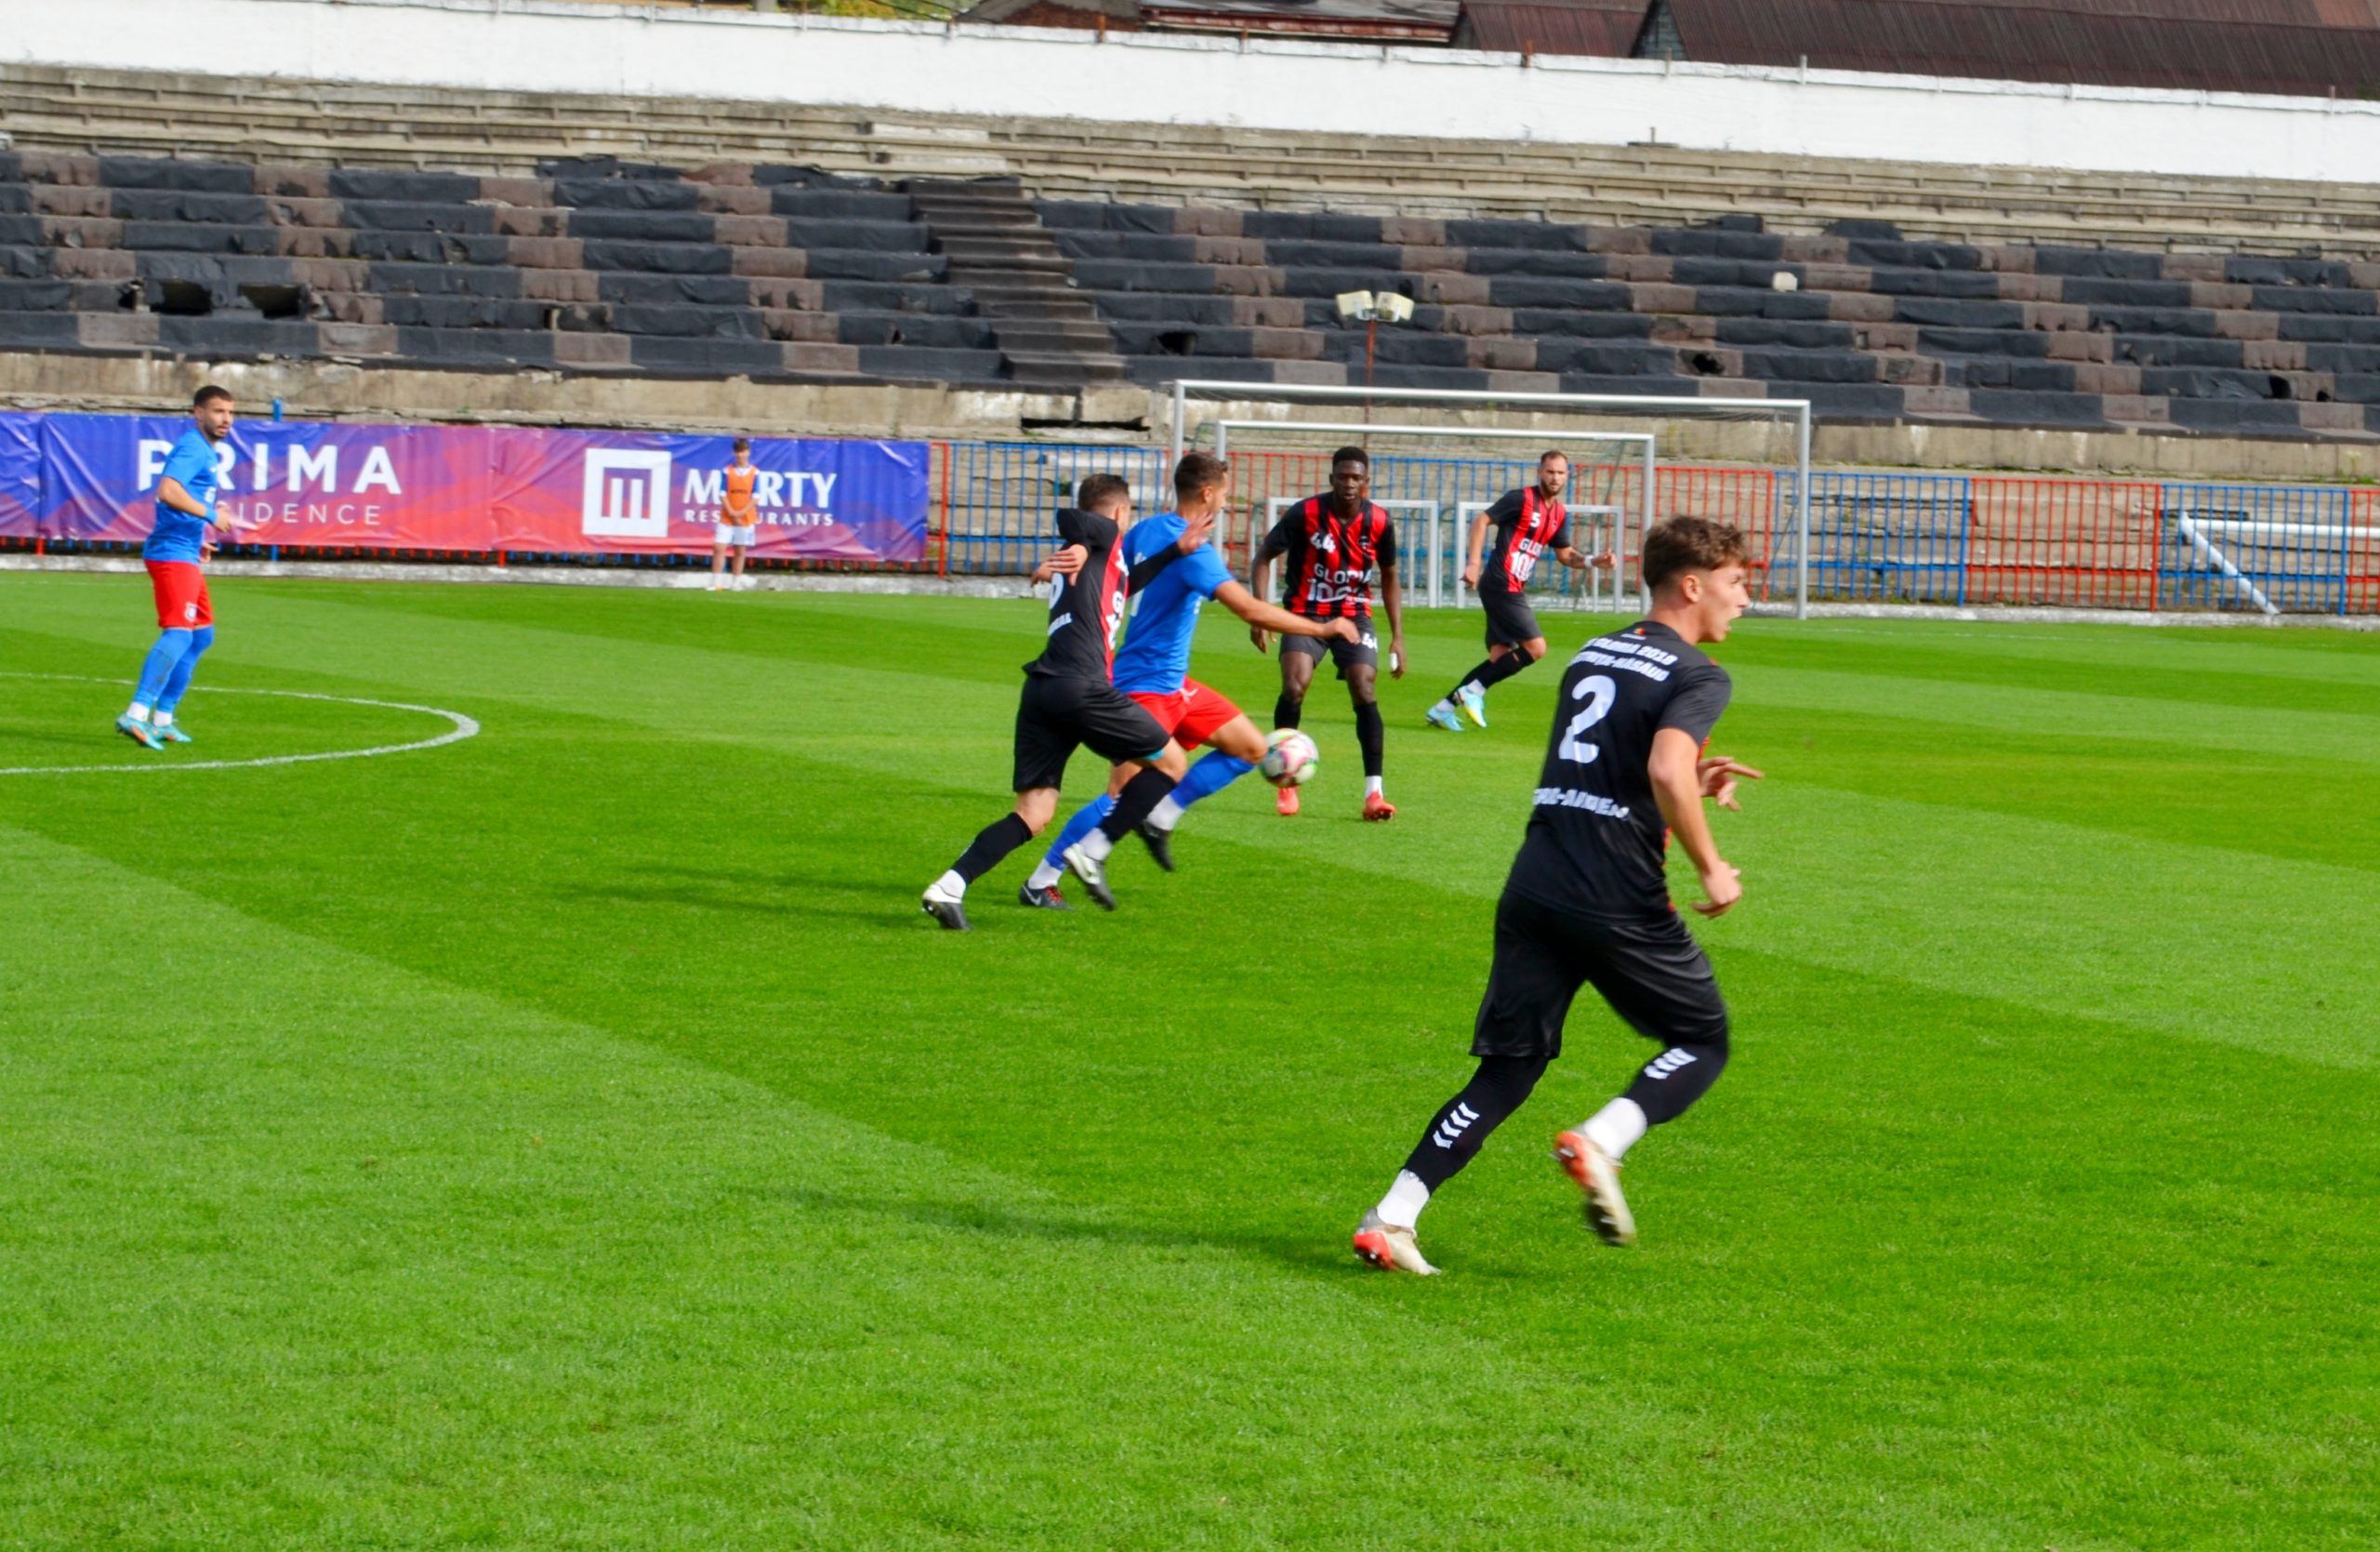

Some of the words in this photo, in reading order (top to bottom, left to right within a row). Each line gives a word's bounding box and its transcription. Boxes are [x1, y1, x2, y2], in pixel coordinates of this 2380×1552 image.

[138, 439, 402, 494] PRIMA
[682, 468, 838, 509] MRTY
[683, 509, 834, 526] RESURANTS
[1529, 511, 1541, 527] 5
[1310, 532, 1336, 553] 44
[1558, 674, 1617, 763] 2
